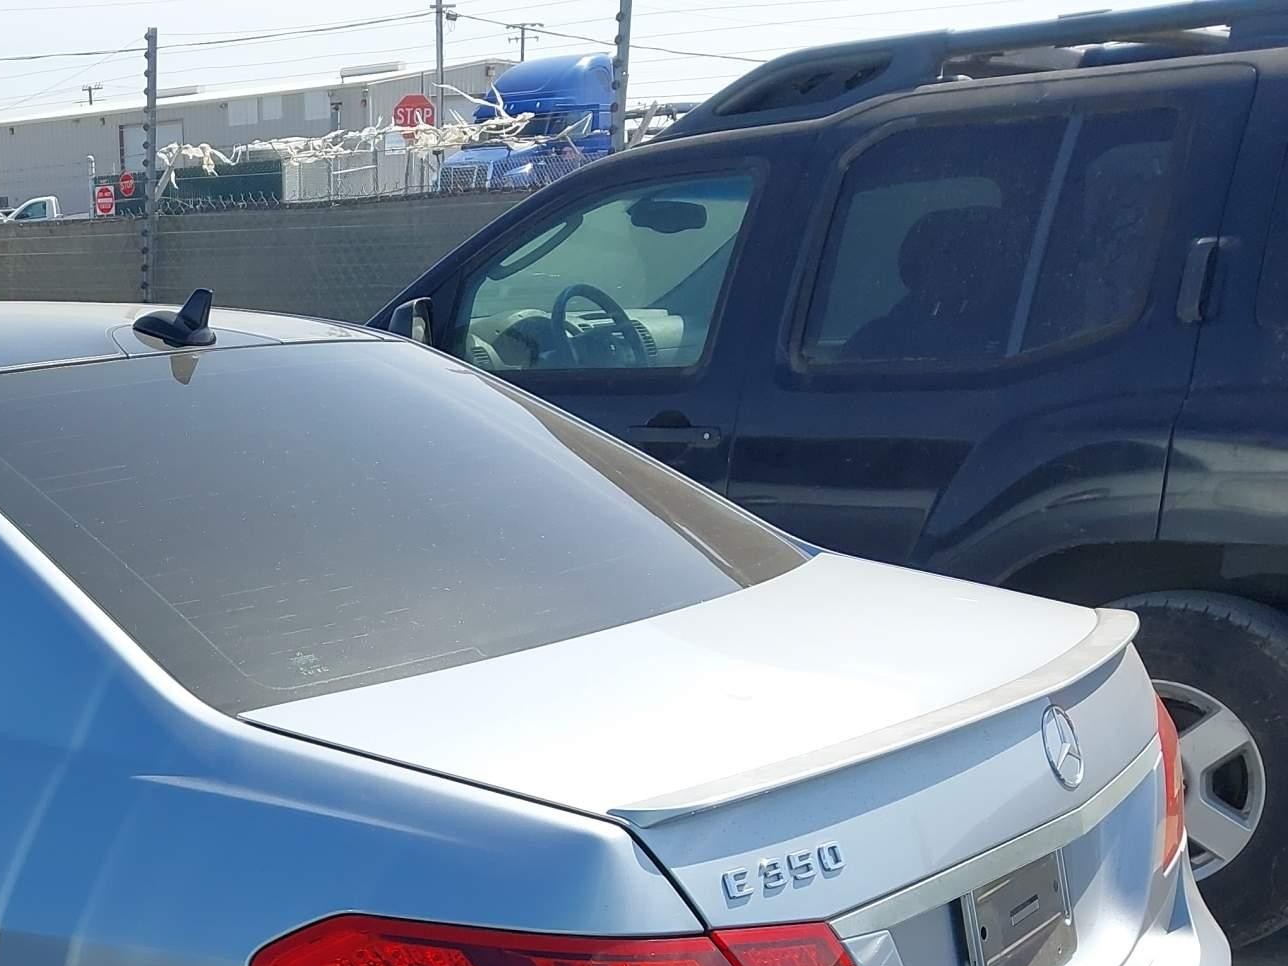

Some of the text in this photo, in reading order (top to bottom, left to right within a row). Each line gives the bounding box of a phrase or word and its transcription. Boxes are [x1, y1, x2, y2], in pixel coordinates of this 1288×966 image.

[396, 107, 432, 124] STOP
[721, 841, 847, 900] E 350
